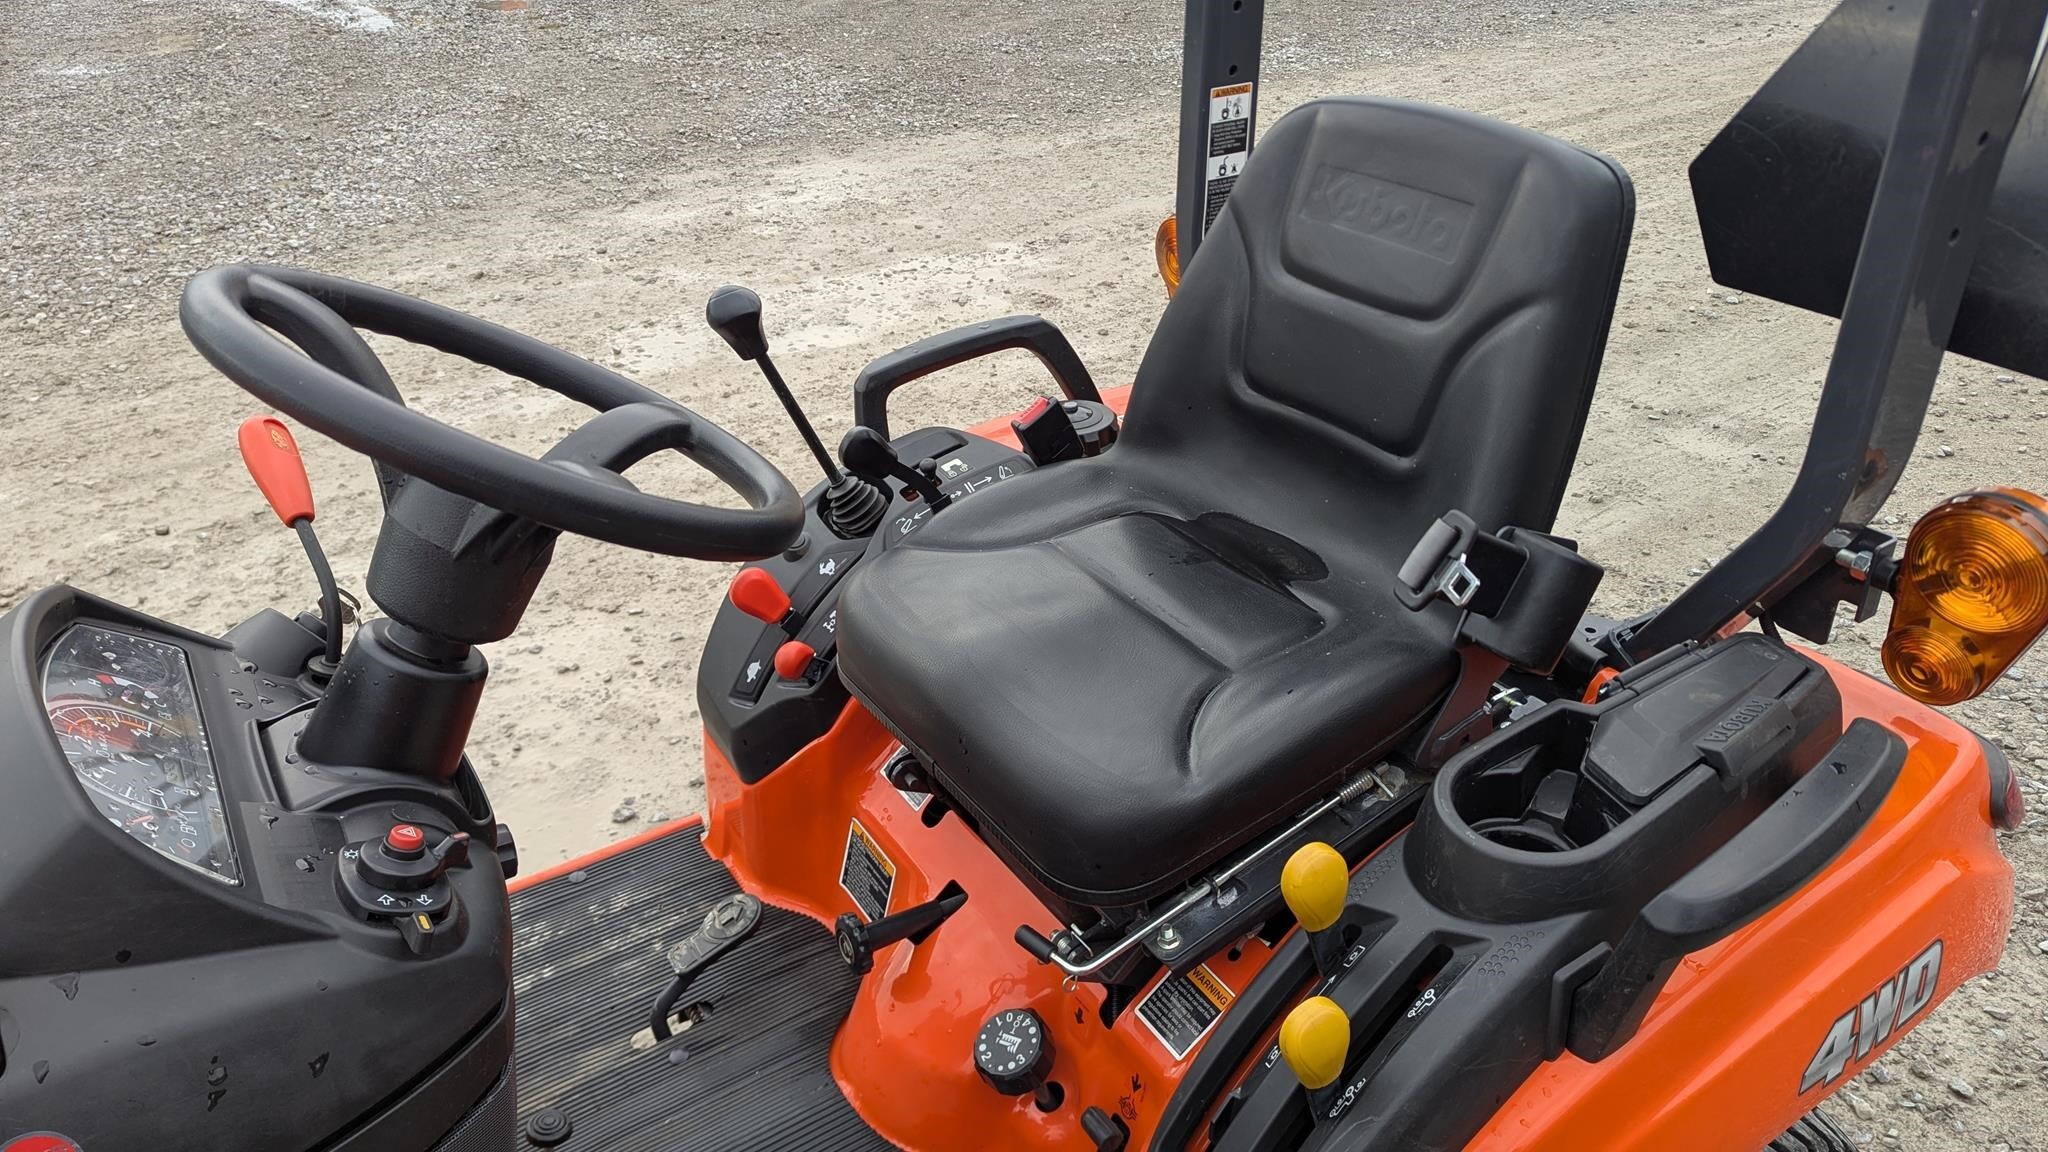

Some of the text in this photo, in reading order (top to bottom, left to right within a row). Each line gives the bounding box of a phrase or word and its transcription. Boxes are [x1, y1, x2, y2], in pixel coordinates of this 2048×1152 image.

[1703, 699, 1773, 743] KUBOTA
[1192, 966, 1228, 1006] WARNING
[995, 1016, 1003, 1027] 1
[1006, 1012, 1014, 1022] 0
[1022, 1017, 1031, 1027] 4
[1798, 938, 1944, 1096] 4WD
[981, 1051, 992, 1062] 2
[1016, 1053, 1026, 1065] 3
